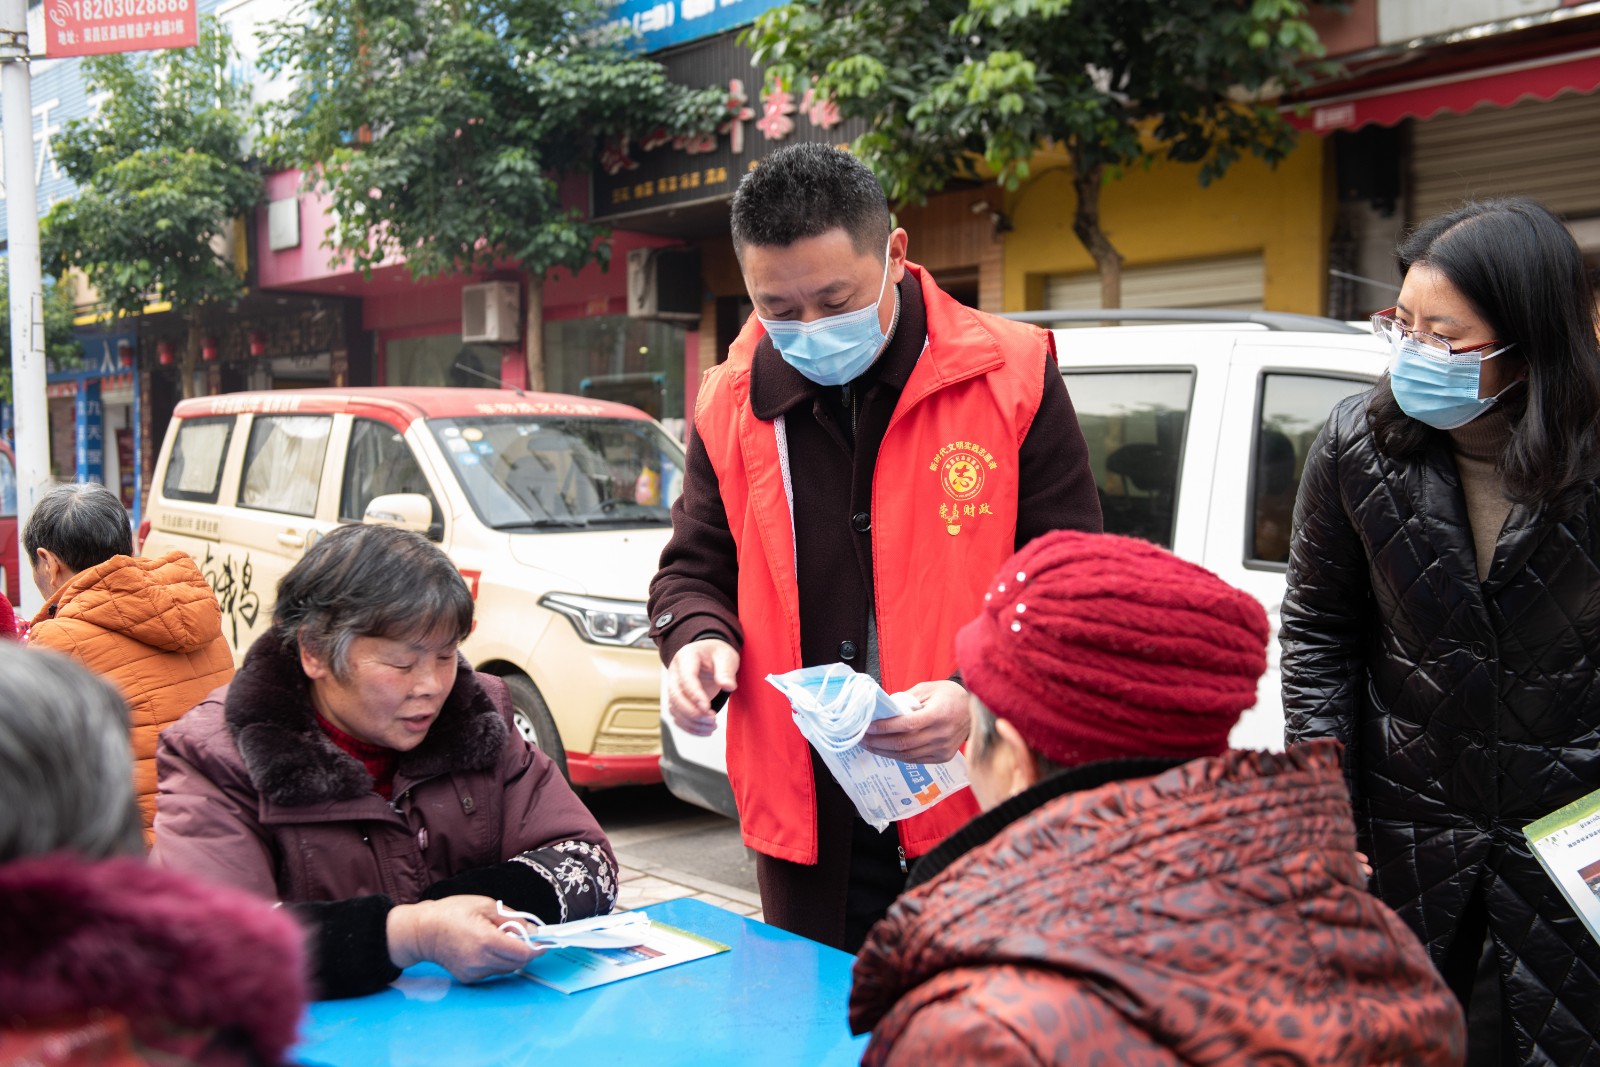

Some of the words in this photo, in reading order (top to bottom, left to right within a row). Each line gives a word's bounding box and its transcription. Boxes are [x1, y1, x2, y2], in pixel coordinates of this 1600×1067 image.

[929, 441, 998, 472] 新时代文明实践志愿者
